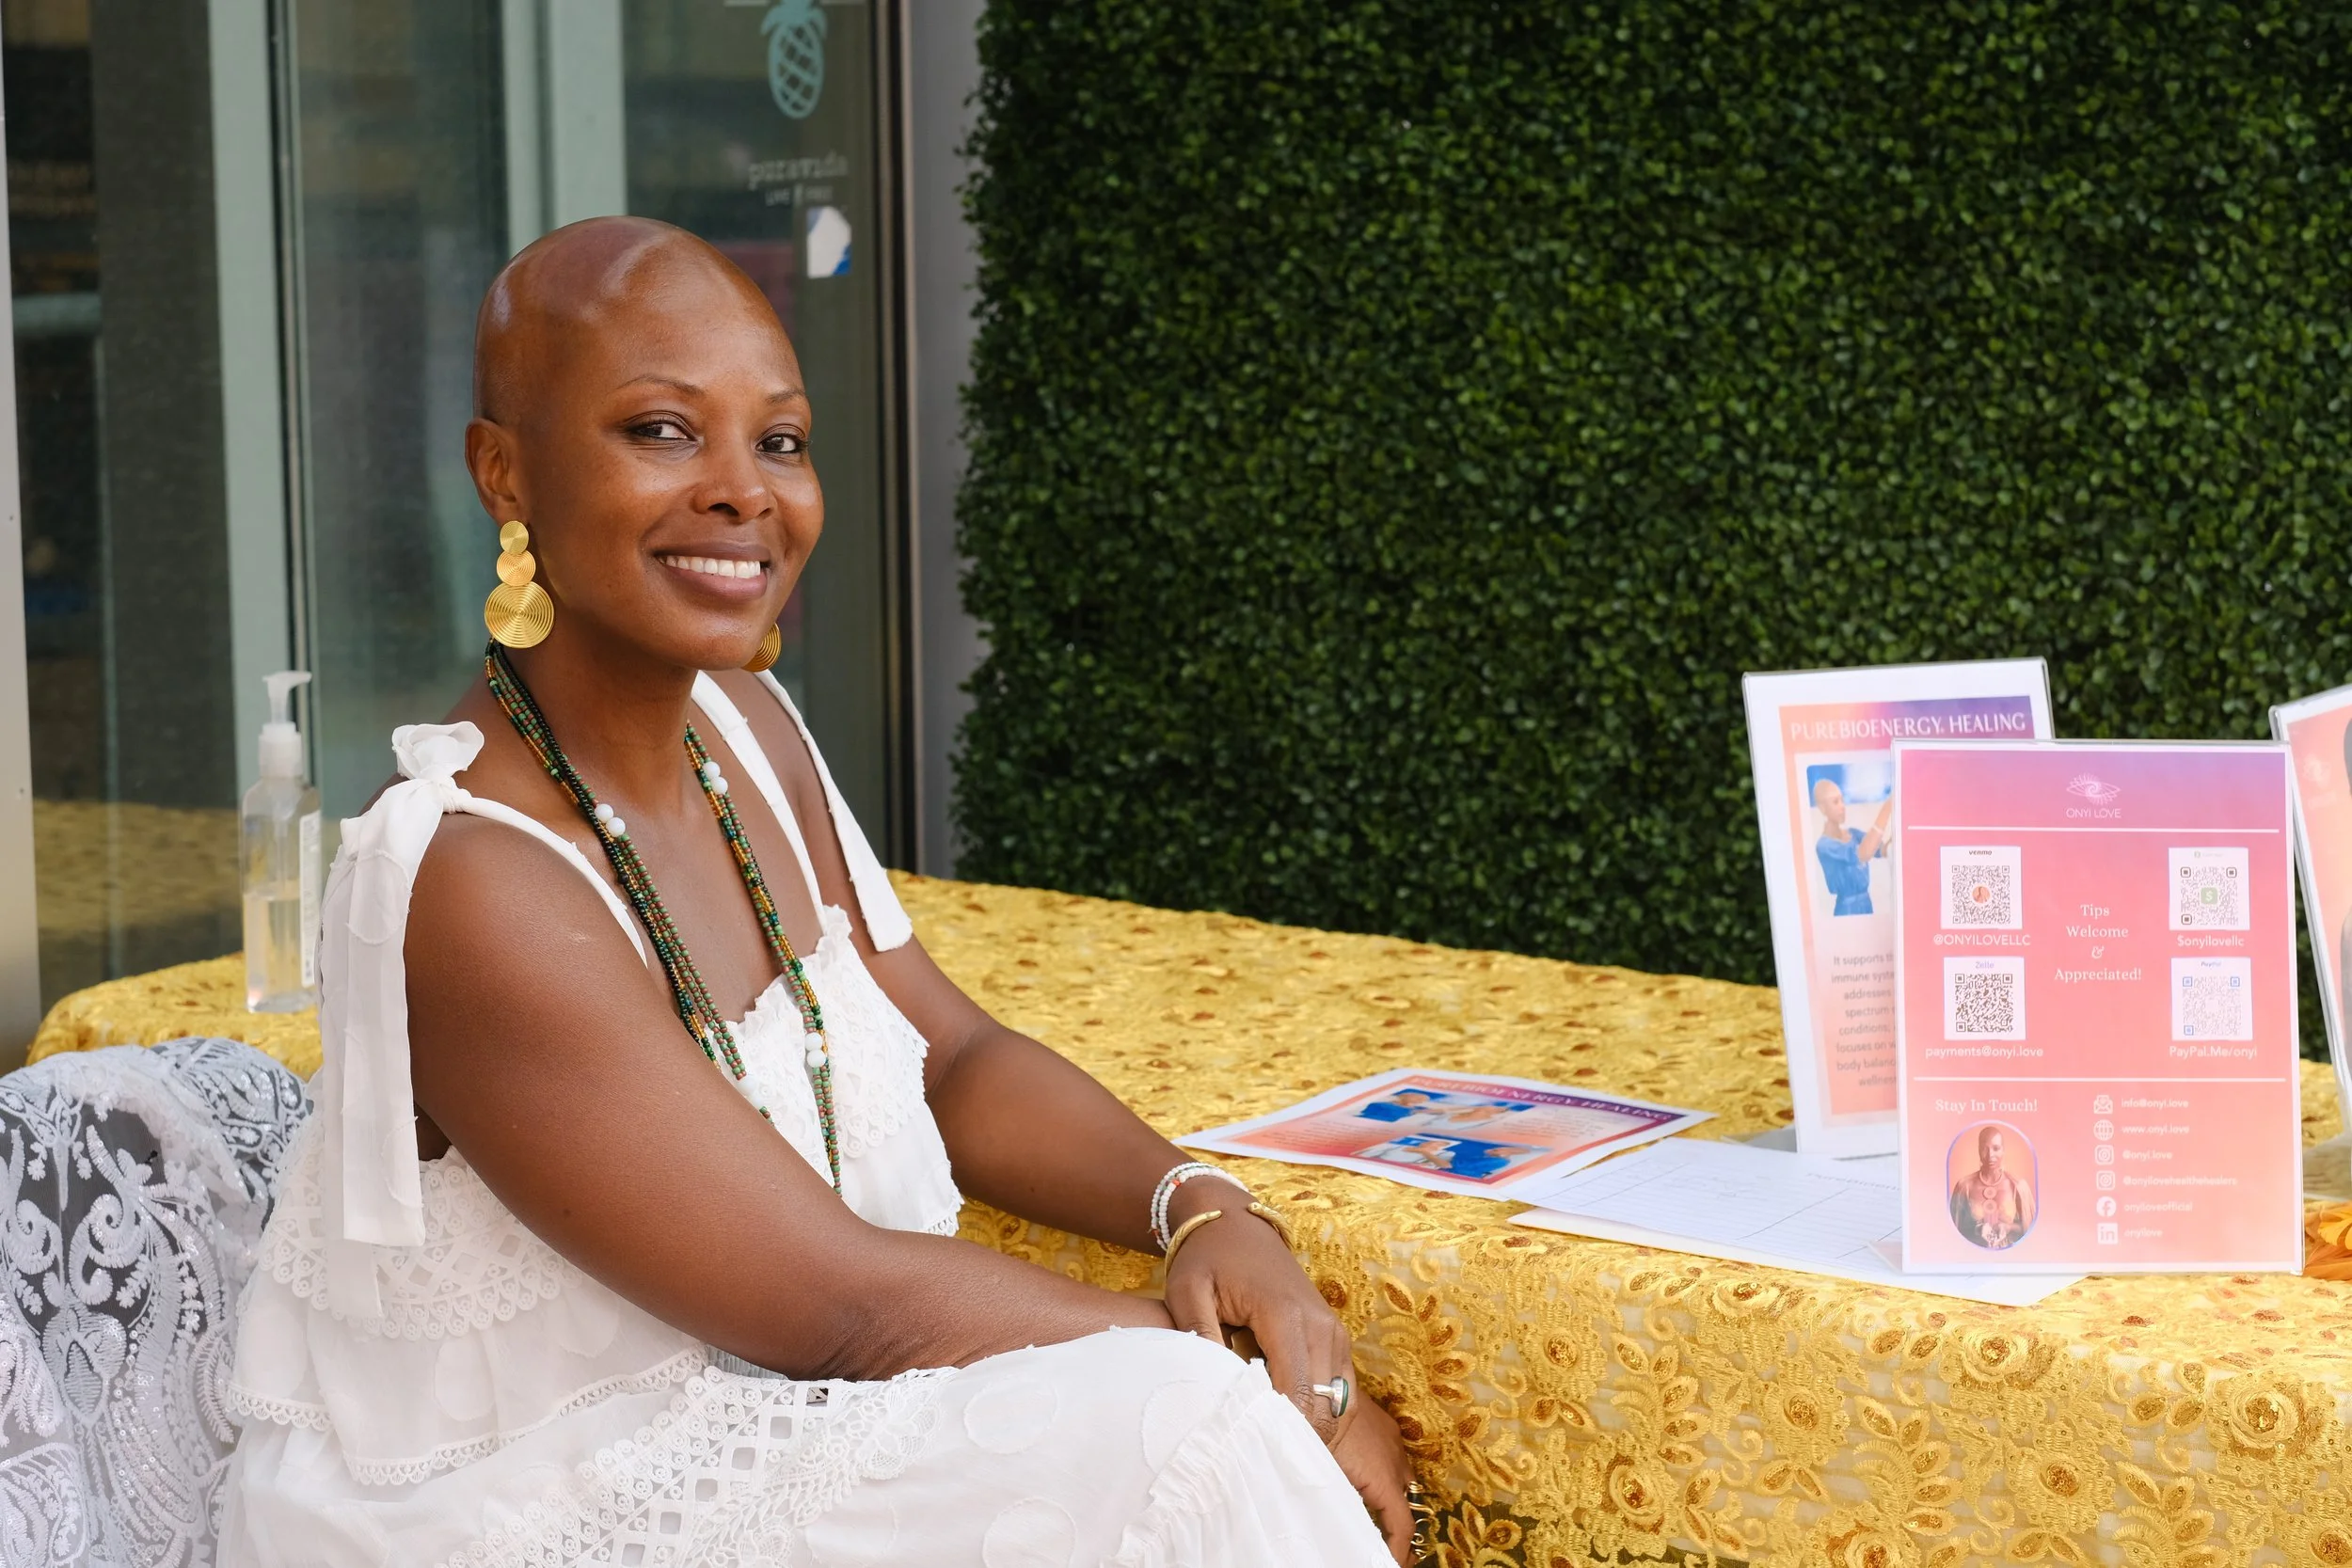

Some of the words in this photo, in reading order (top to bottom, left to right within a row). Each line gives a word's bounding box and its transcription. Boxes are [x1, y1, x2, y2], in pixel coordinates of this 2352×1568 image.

[1949, 712, 2026, 735] HEALING
[2065, 808, 2091, 818] ONYI
[2093, 808, 2122, 818] LOVE
[2080, 904, 2110, 920] Tips
[2065, 925, 2129, 938] Welcome
[1933, 933, 2031, 946] @ONYILOVELLC
[2091, 945, 2105, 959] &
[1842, 953, 1883, 967] supports
[1831, 973, 1869, 984] immune
[2055, 967, 2142, 984] Appreciated!
[1843, 989, 1892, 1001] addresses
[1845, 1006, 1889, 1020] spectrum
[1836, 1041, 1872, 1053] focuses
[1874, 1041, 1886, 1051] on
[1925, 1045, 2043, 1059] payments@onyi.love
[1836, 1059, 1861, 1071] body
[1935, 1099, 1966, 1114] Stay
[1970, 1099, 1985, 1112] In
[1988, 1098, 2039, 1112] Touch!
[2099, 1226, 2115, 1242] in
